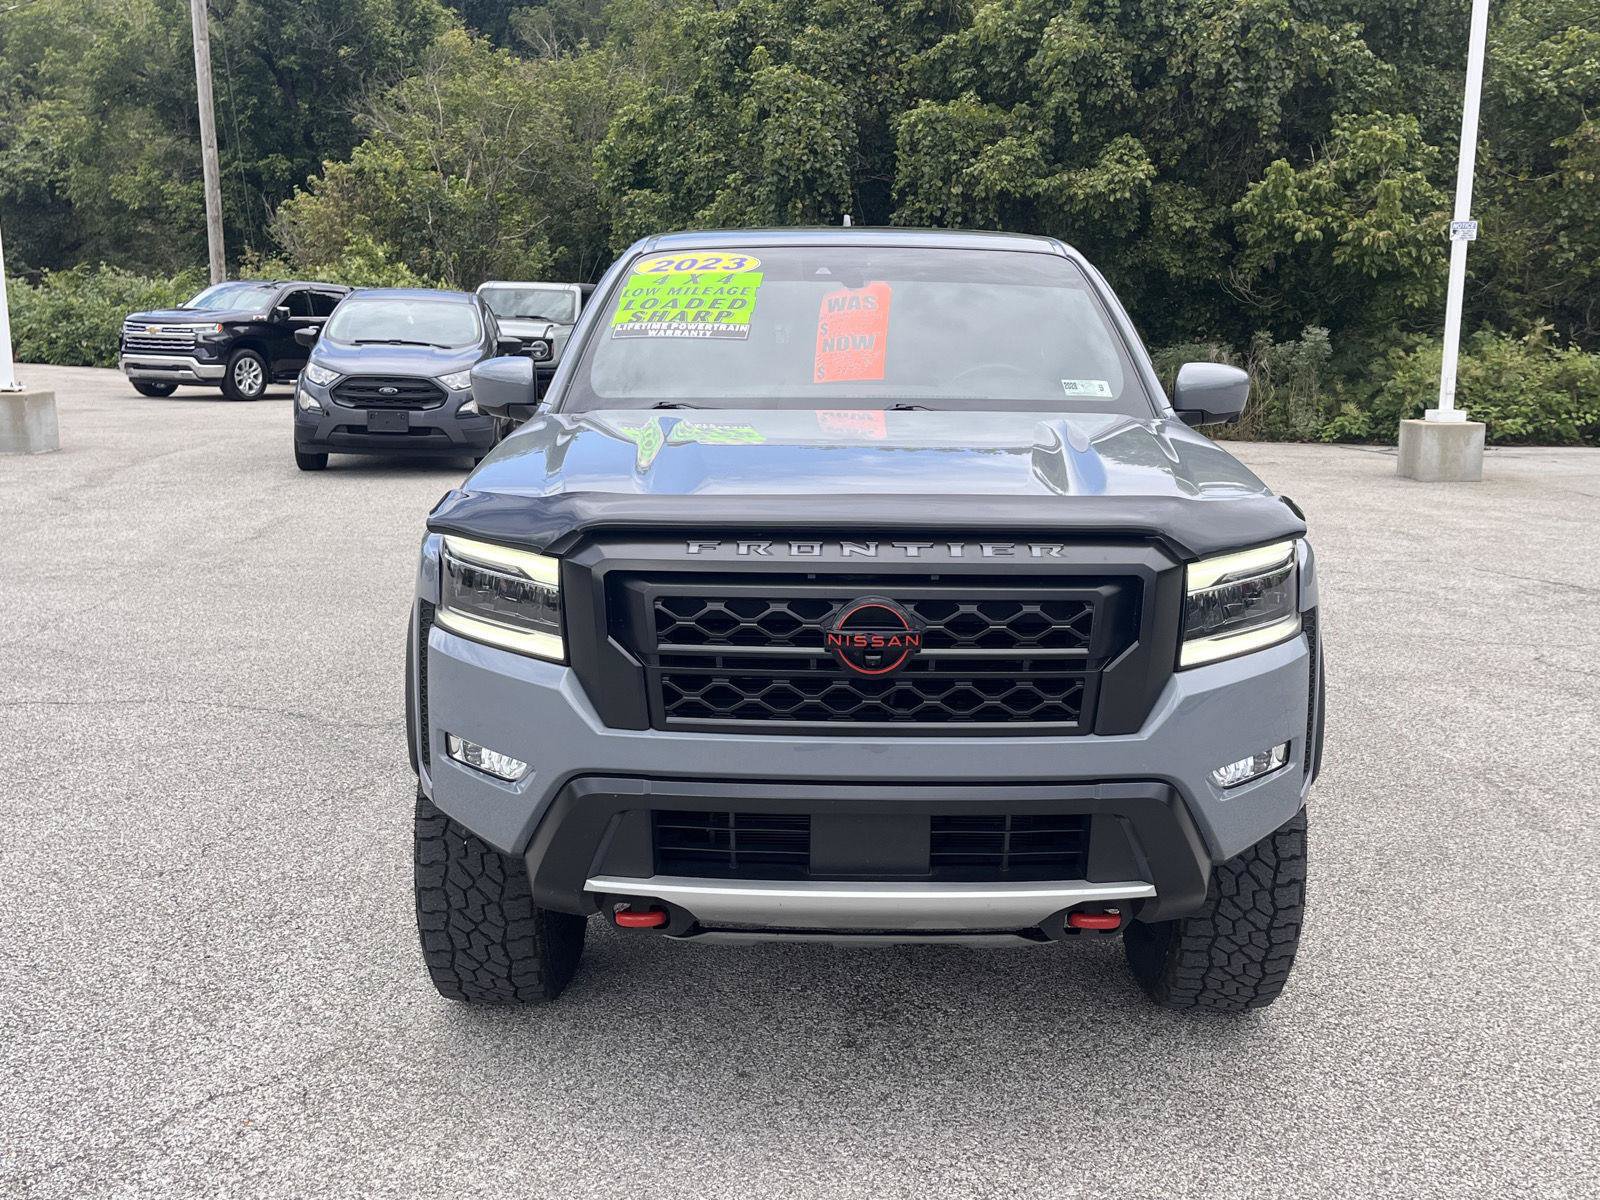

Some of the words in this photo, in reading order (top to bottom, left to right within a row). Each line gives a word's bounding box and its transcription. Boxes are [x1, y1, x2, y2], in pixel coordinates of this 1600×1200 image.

[649, 257, 748, 272] 2023
[622, 287, 661, 297] LOW
[667, 286, 750, 296] MILEAGE
[622, 298, 748, 311] LOADED
[827, 295, 877, 313] WAS
[627, 310, 734, 323] SHARP
[616, 322, 668, 331] LIFETIME
[670, 322, 749, 332] POWERTRAIN
[648, 330, 713, 338] WARRANTY
[822, 335, 876, 353] NOW
[686, 540, 1067, 558] FRONTIER
[827, 633, 920, 649] NISSAN
